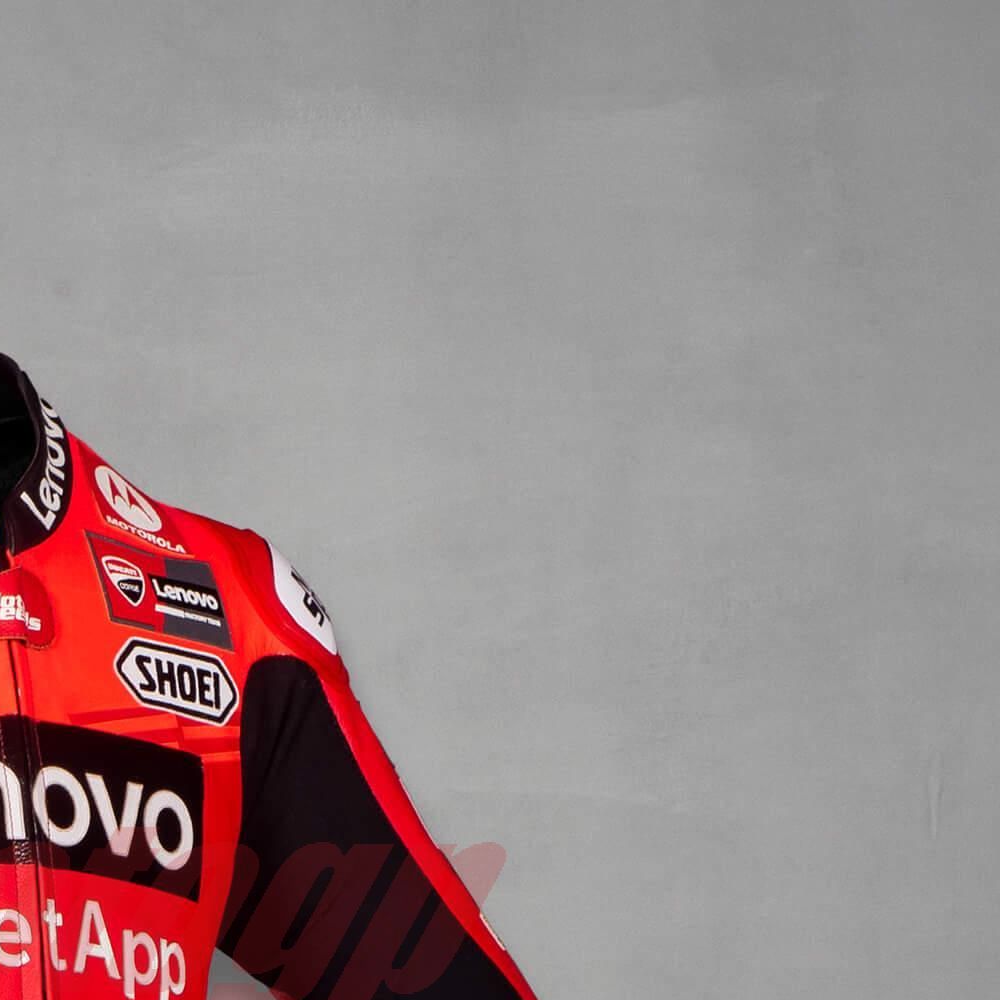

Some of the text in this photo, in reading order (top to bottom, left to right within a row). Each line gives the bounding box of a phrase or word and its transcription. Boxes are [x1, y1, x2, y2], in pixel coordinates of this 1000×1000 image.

[105, 514, 188, 554] MOTOROLA
[151, 577, 219, 610] Lenovo
[137, 655, 222, 710] SHOEI
